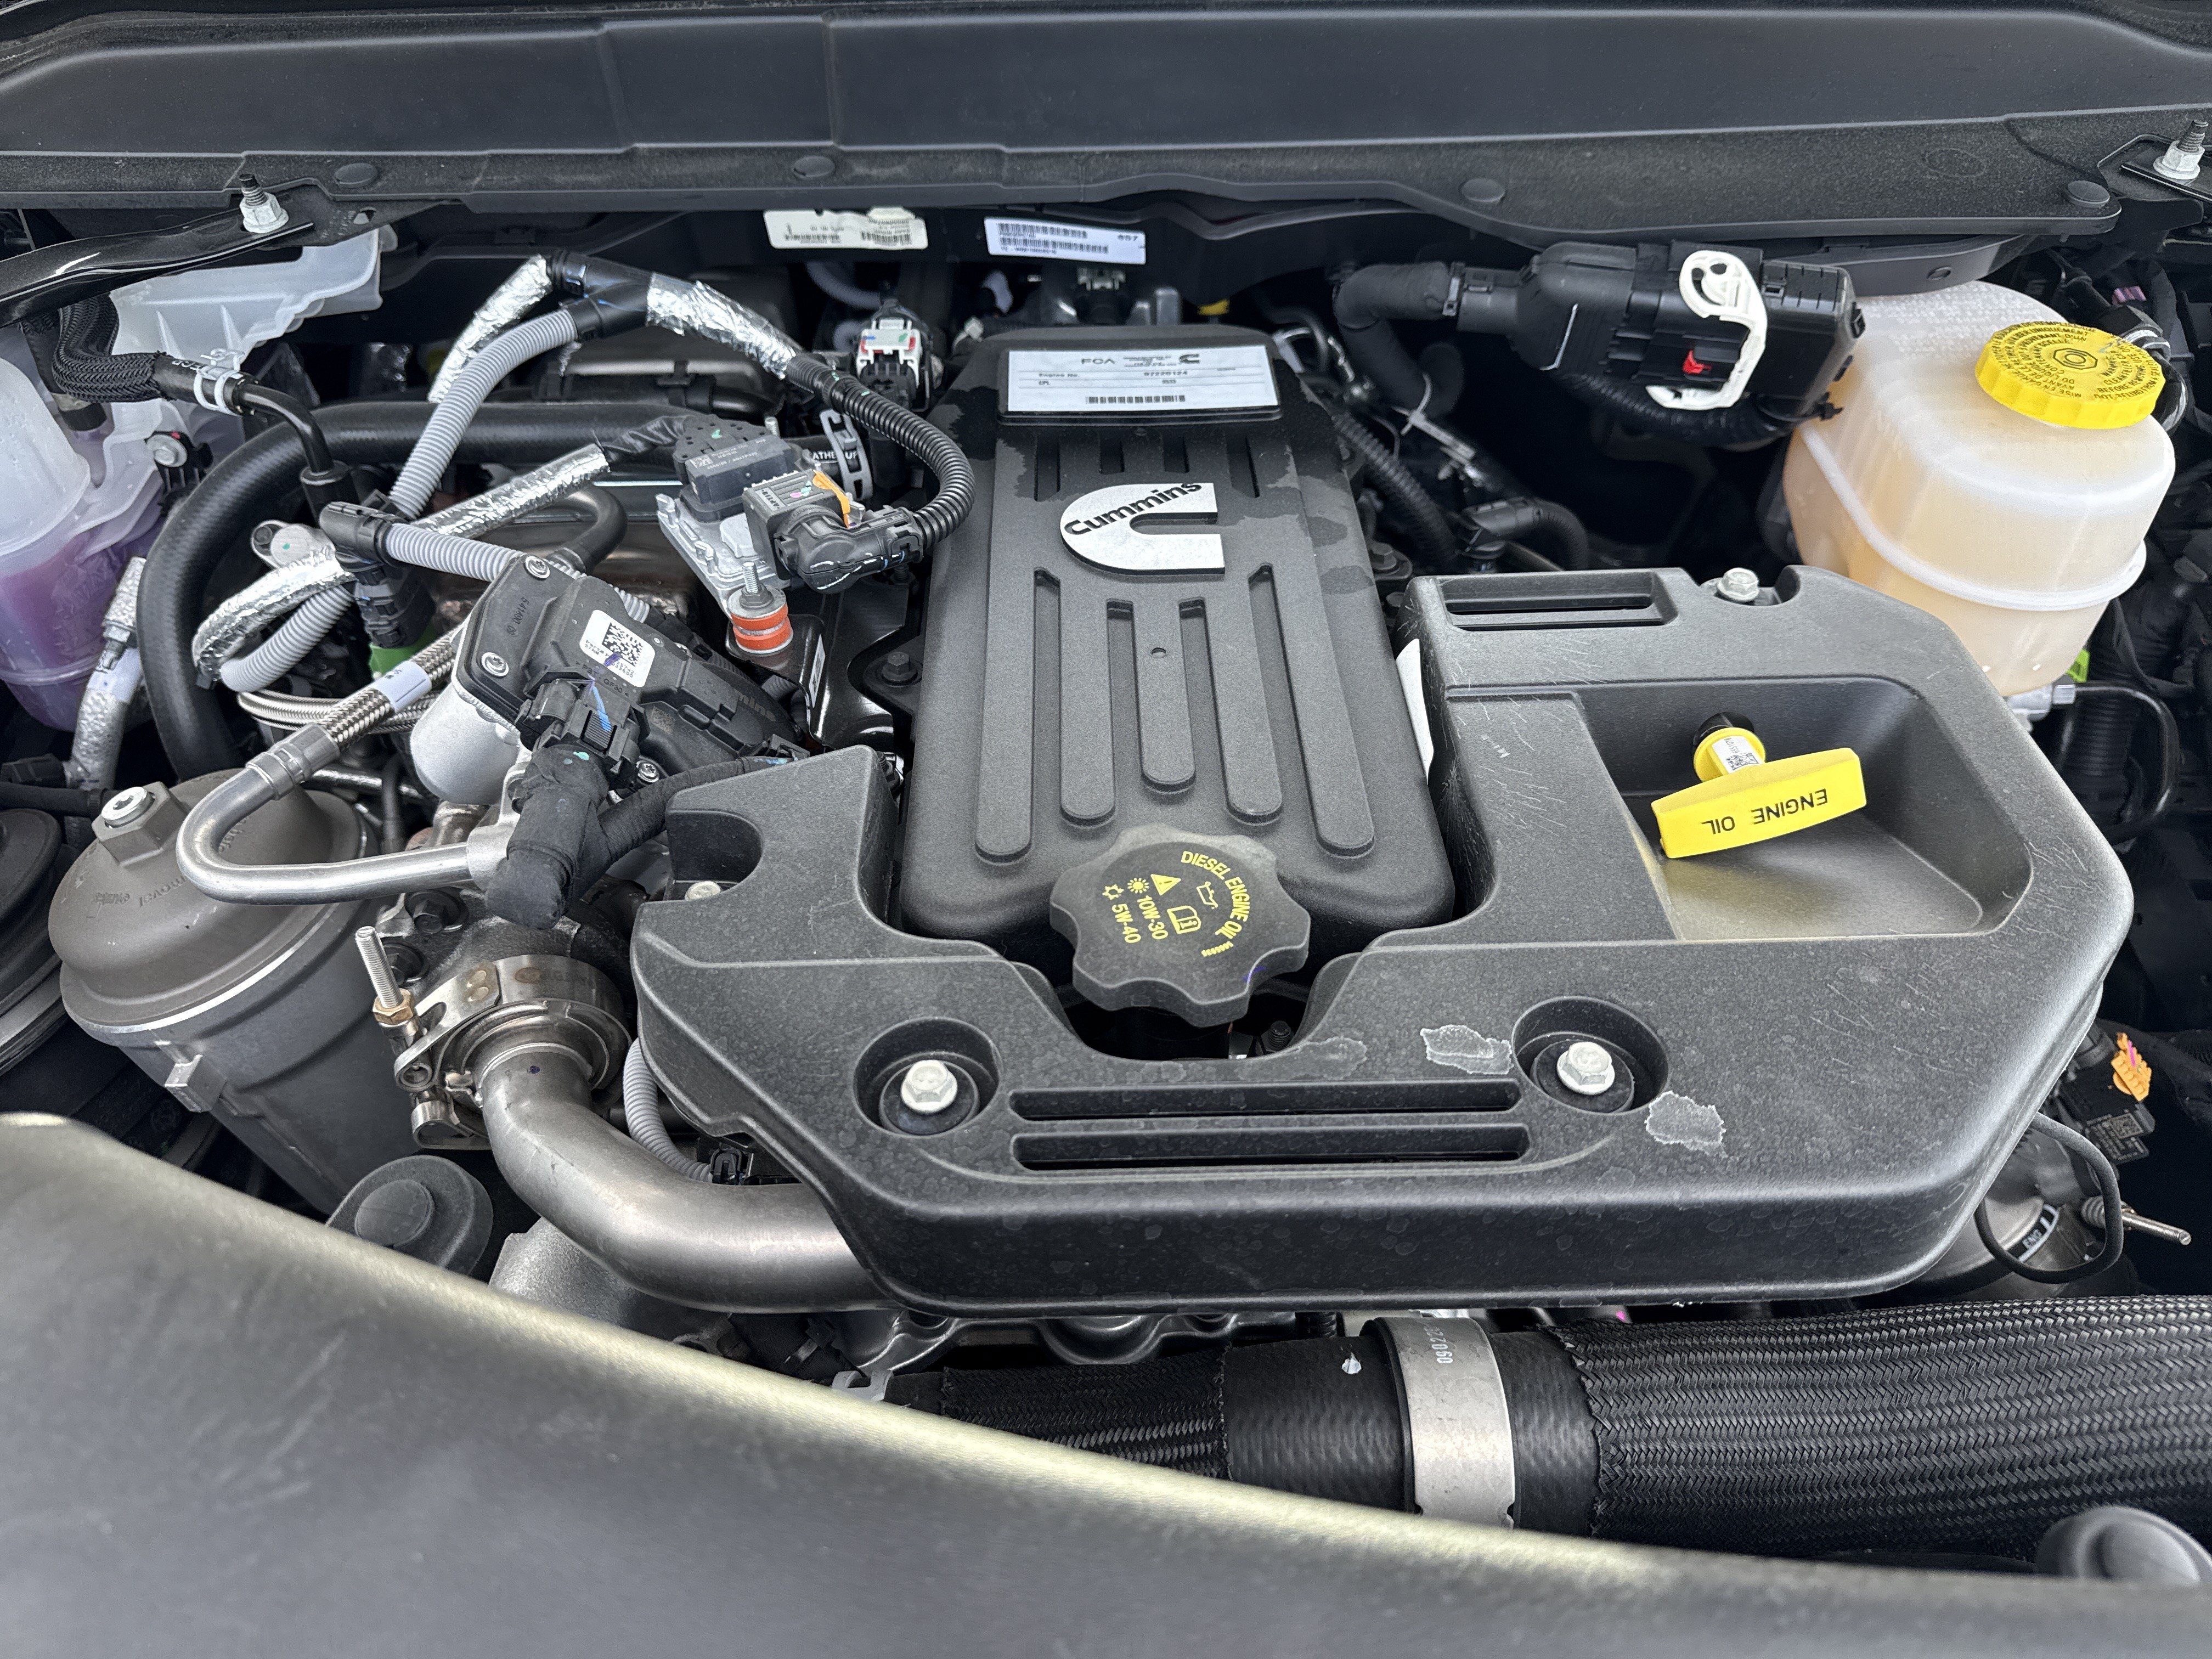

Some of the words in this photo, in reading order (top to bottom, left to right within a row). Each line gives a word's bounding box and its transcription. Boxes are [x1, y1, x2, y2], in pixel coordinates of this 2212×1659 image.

[2096, 383, 2134, 393] BEFORE
[1064, 483, 1203, 535] Cummins
[1700, 816, 1736, 834] OIL
[1751, 788, 1829, 825] ENGINE
[1181, 850, 1232, 881] DIESEL
[1137, 895, 1169, 940] 10W-30
[1224, 877, 1251, 923] ENGINE
[1111, 904, 1142, 944] 5W-40
[1214, 920, 1242, 939] OIL
